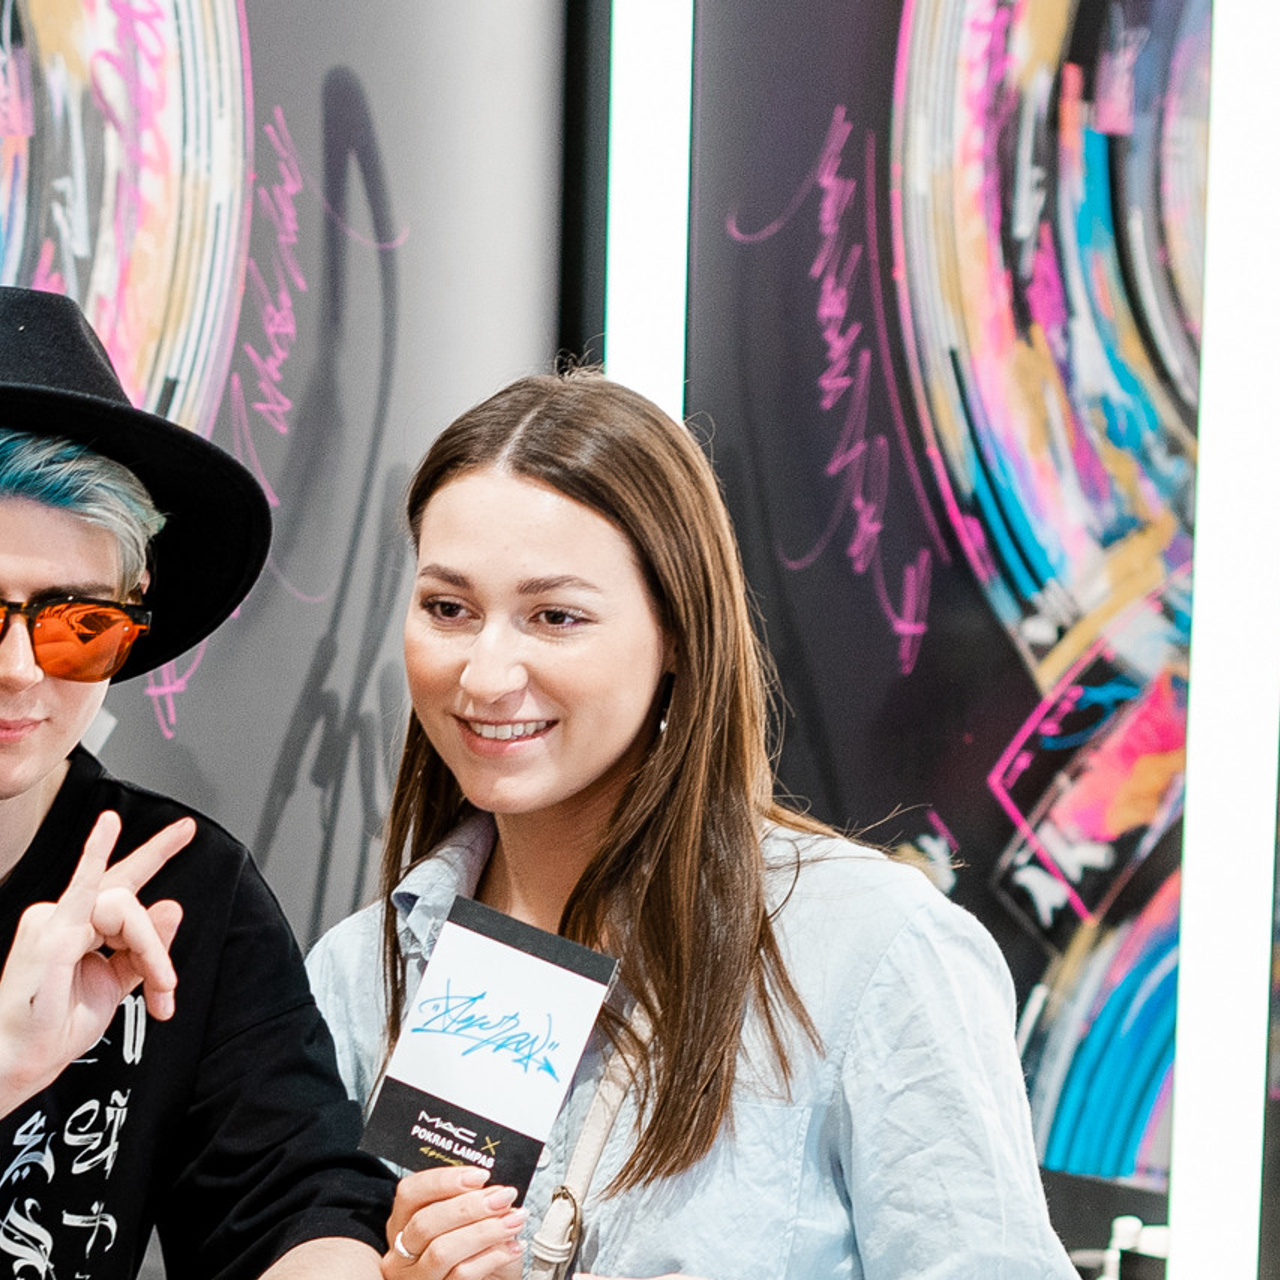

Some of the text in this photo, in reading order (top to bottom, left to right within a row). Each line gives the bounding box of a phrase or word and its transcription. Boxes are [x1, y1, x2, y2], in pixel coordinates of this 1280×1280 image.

[418, 1110, 477, 1144] MAC
[411, 1125, 453, 1151] POKRAS
[452, 1143, 495, 1168] LAMPAS
